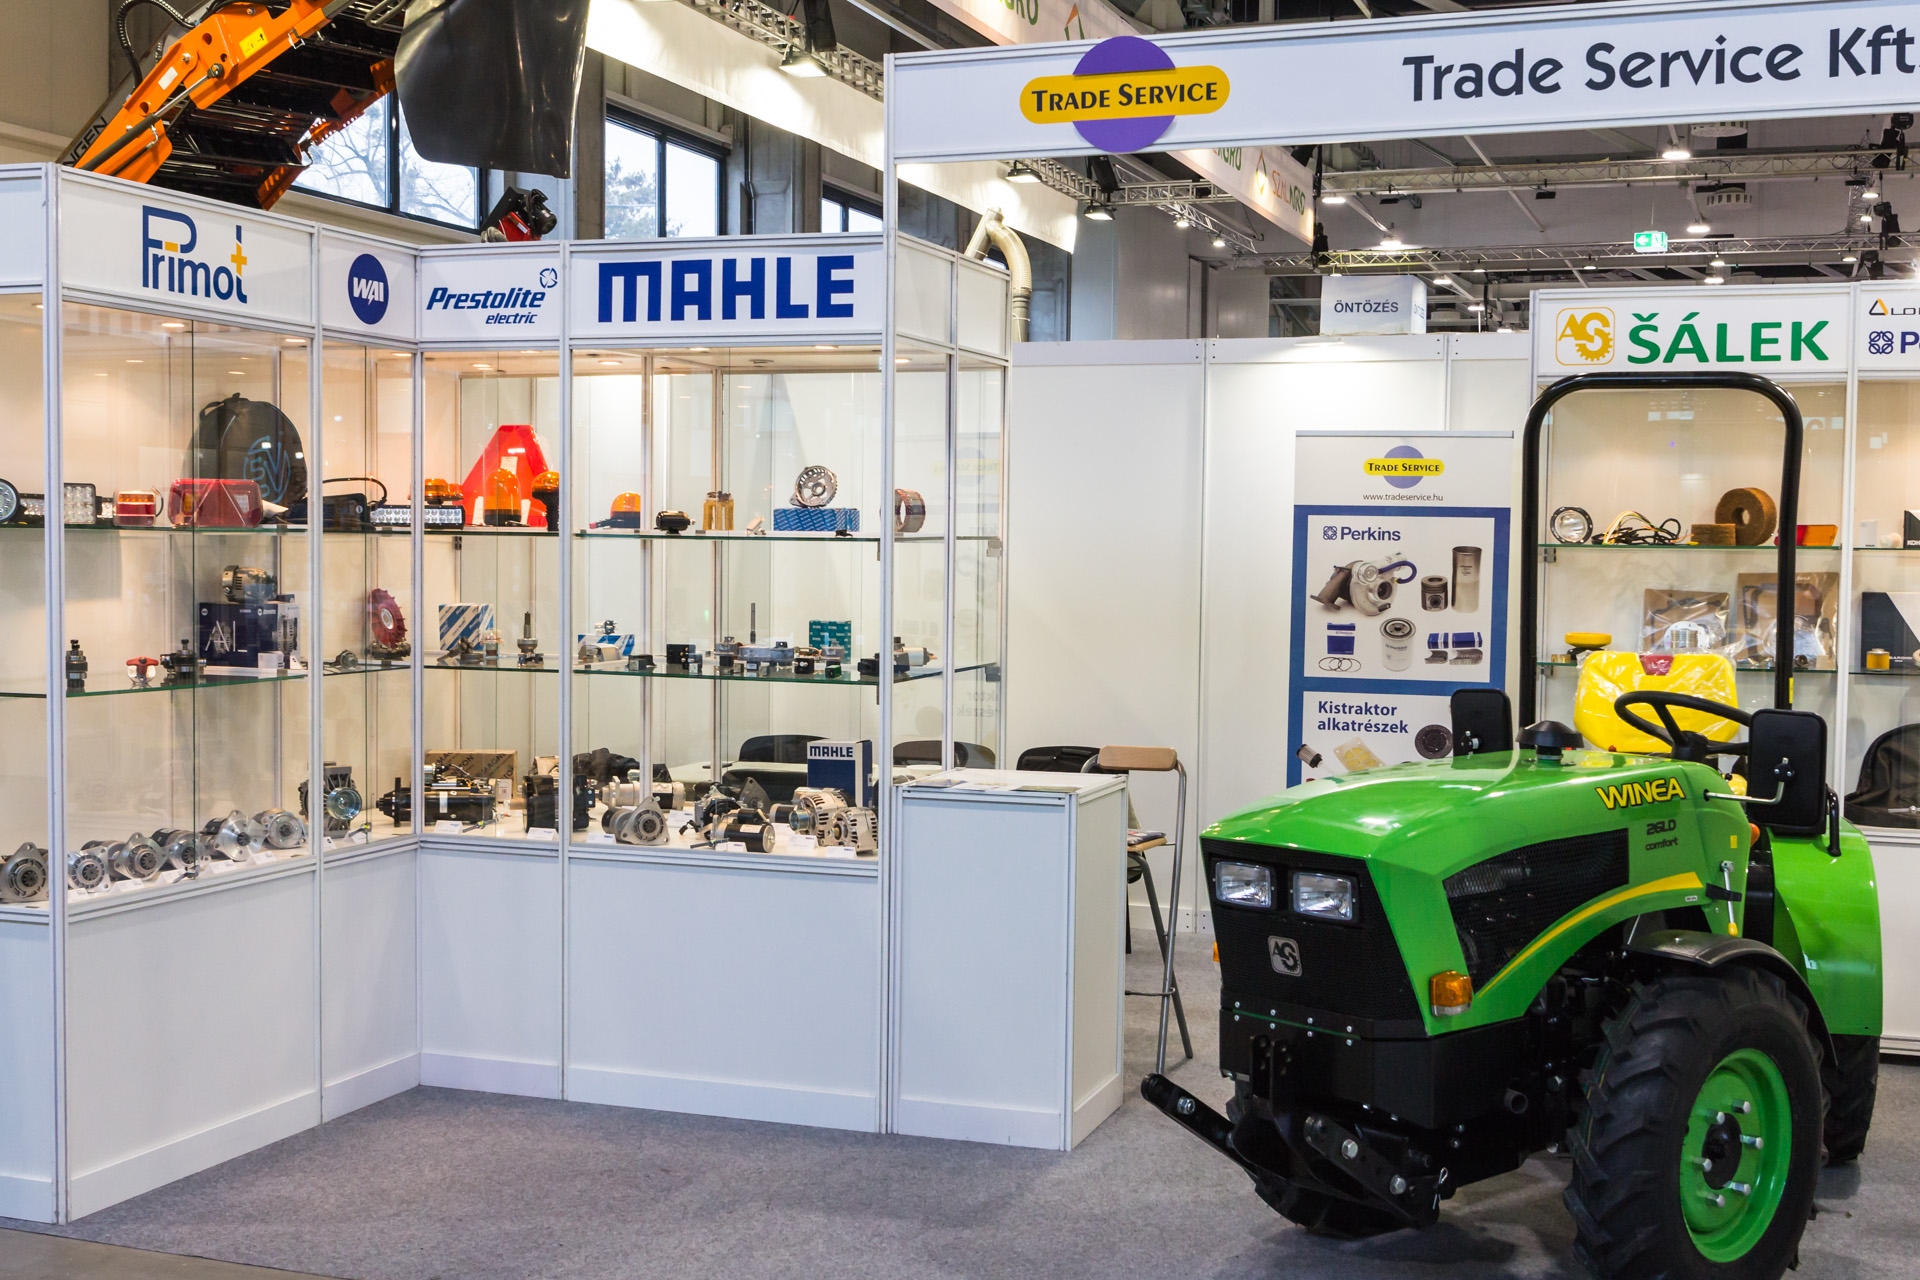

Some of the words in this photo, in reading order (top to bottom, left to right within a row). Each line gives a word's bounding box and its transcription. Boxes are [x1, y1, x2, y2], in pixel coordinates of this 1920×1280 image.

[1402, 48, 1563, 102] Trade
[1585, 35, 1804, 91] Service
[142, 205, 248, 304] Primot
[353, 276, 384, 306] WAI
[598, 255, 854, 323] MAHLE
[426, 287, 546, 310] Prestolite
[1334, 299, 1399, 313] ÖNTÖZÉS
[485, 312, 538, 325] electric
[1627, 312, 1830, 364] ŠÁLEK
[1363, 493, 1444, 502] www.tradeservice.hu
[1340, 526, 1401, 541] Perkins
[1318, 701, 1398, 716] Kistraktor
[1317, 717, 1408, 734] alkatrészek
[809, 745, 854, 758] MAHLE
[1595, 776, 1687, 810] WINEA
[1645, 836, 1679, 851] comfort
